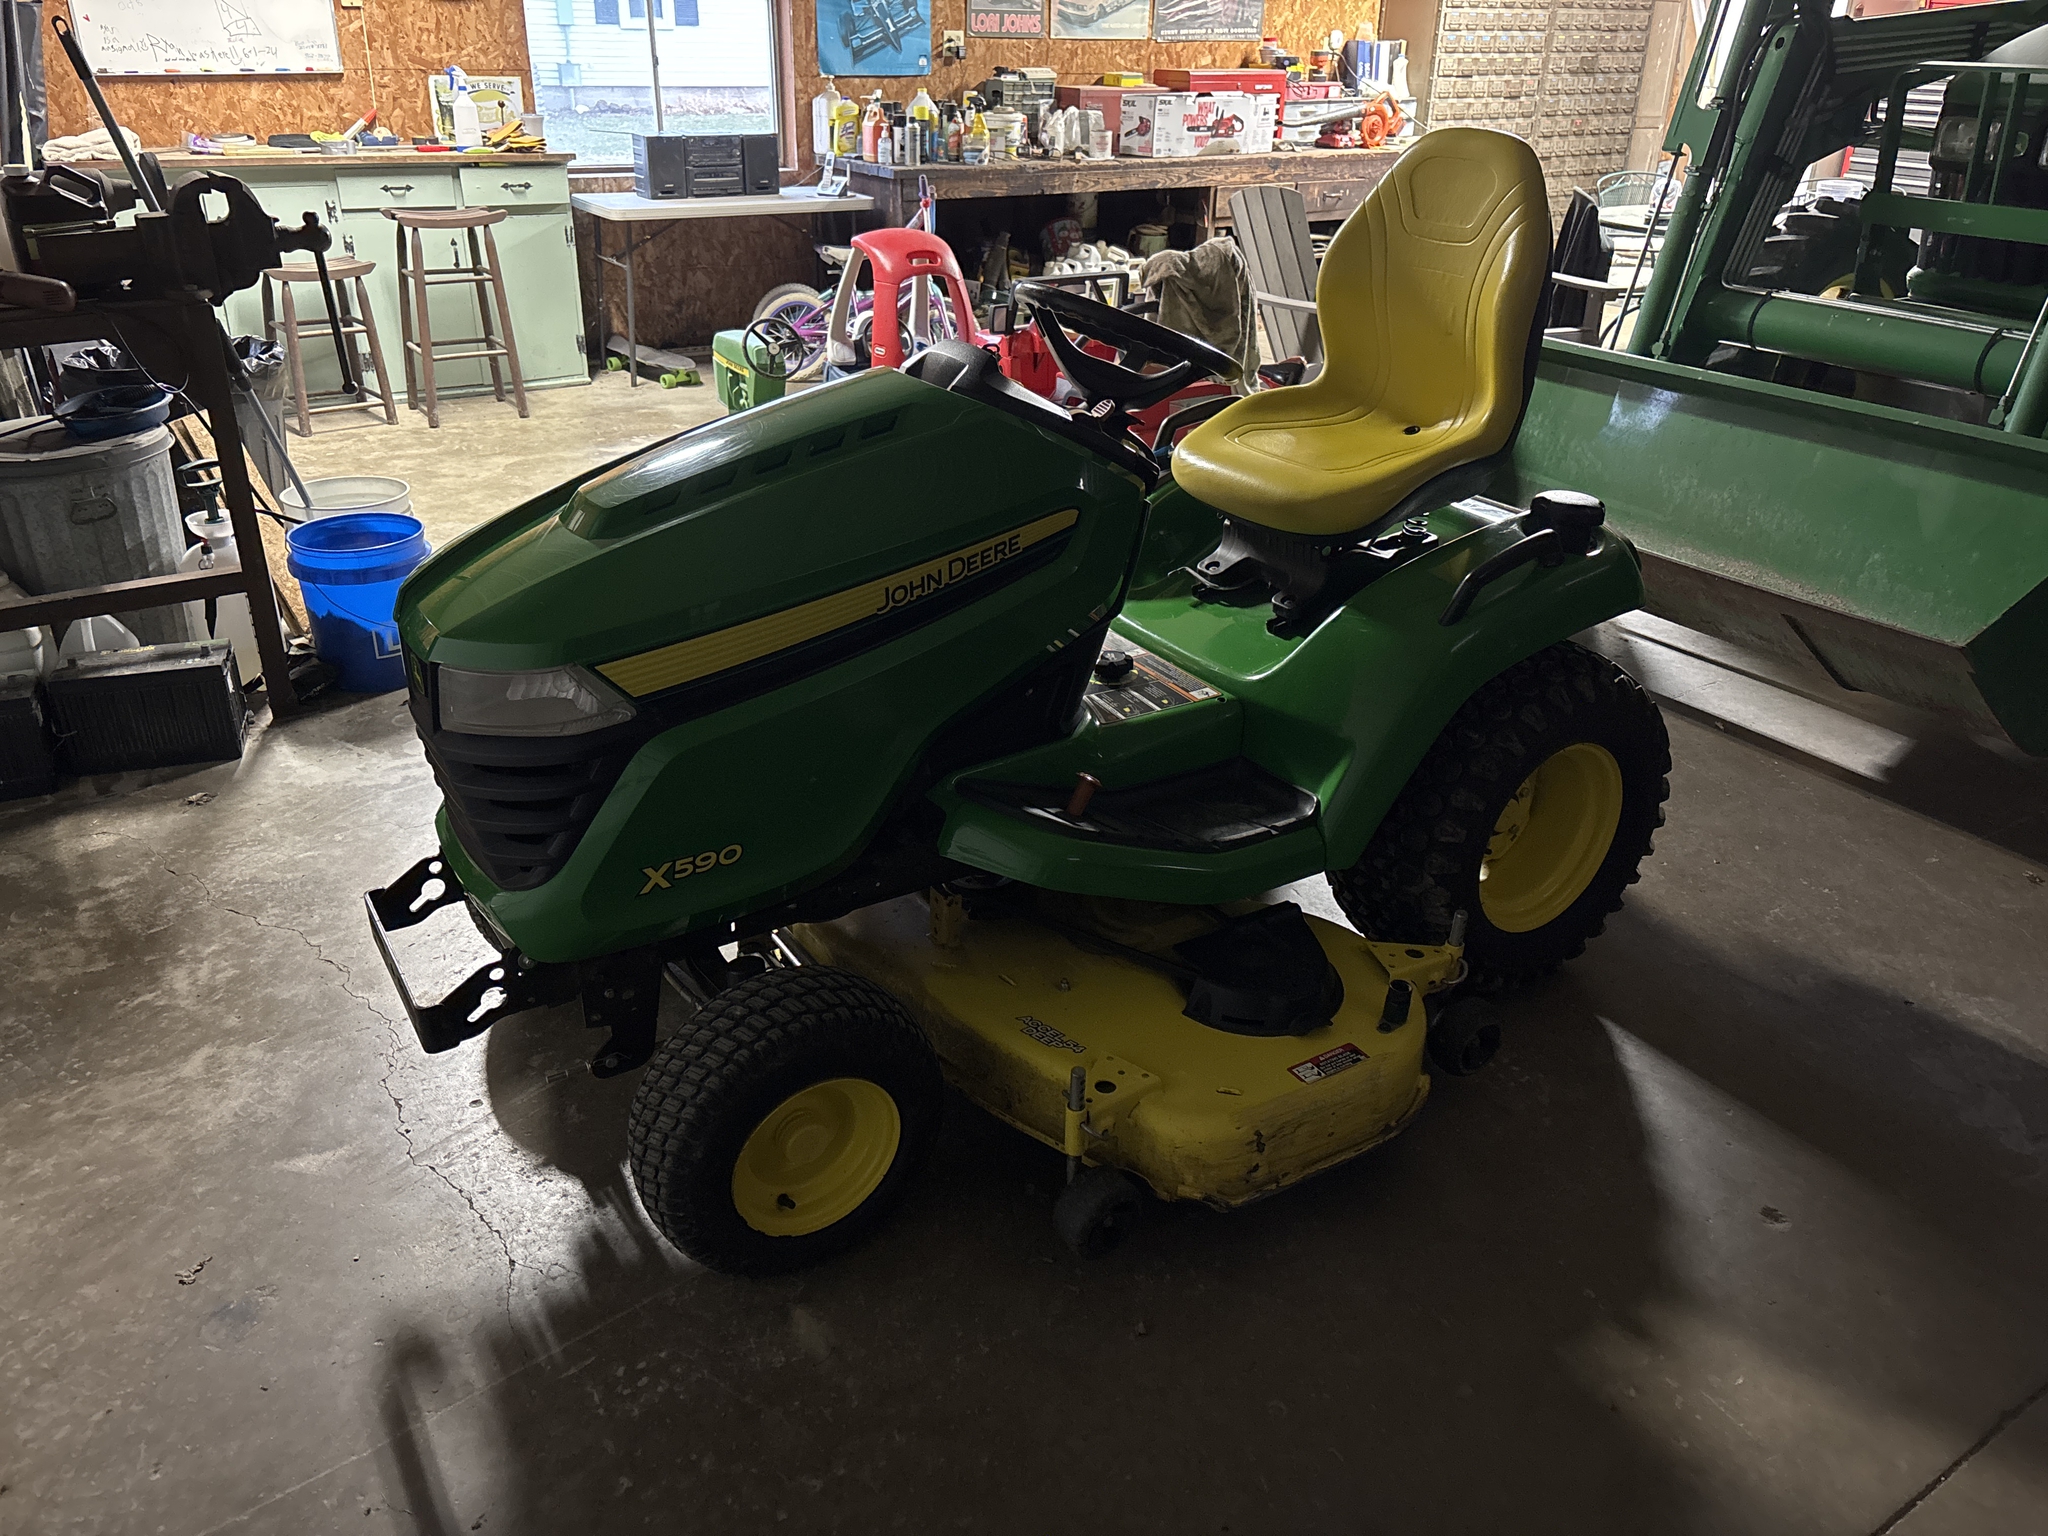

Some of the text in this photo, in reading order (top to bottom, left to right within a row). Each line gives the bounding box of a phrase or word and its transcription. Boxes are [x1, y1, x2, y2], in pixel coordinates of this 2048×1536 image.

[971, 13, 1041, 33] LORI JOHNS
[1198, 101, 1216, 114] WHAT
[1182, 113, 1209, 126] POWERS
[876, 533, 1023, 613] JOHN DEERE
[636, 843, 743, 896] X590
[1015, 1015, 1066, 1042] ACCEL
[1020, 1026, 1064, 1048] DEEP
